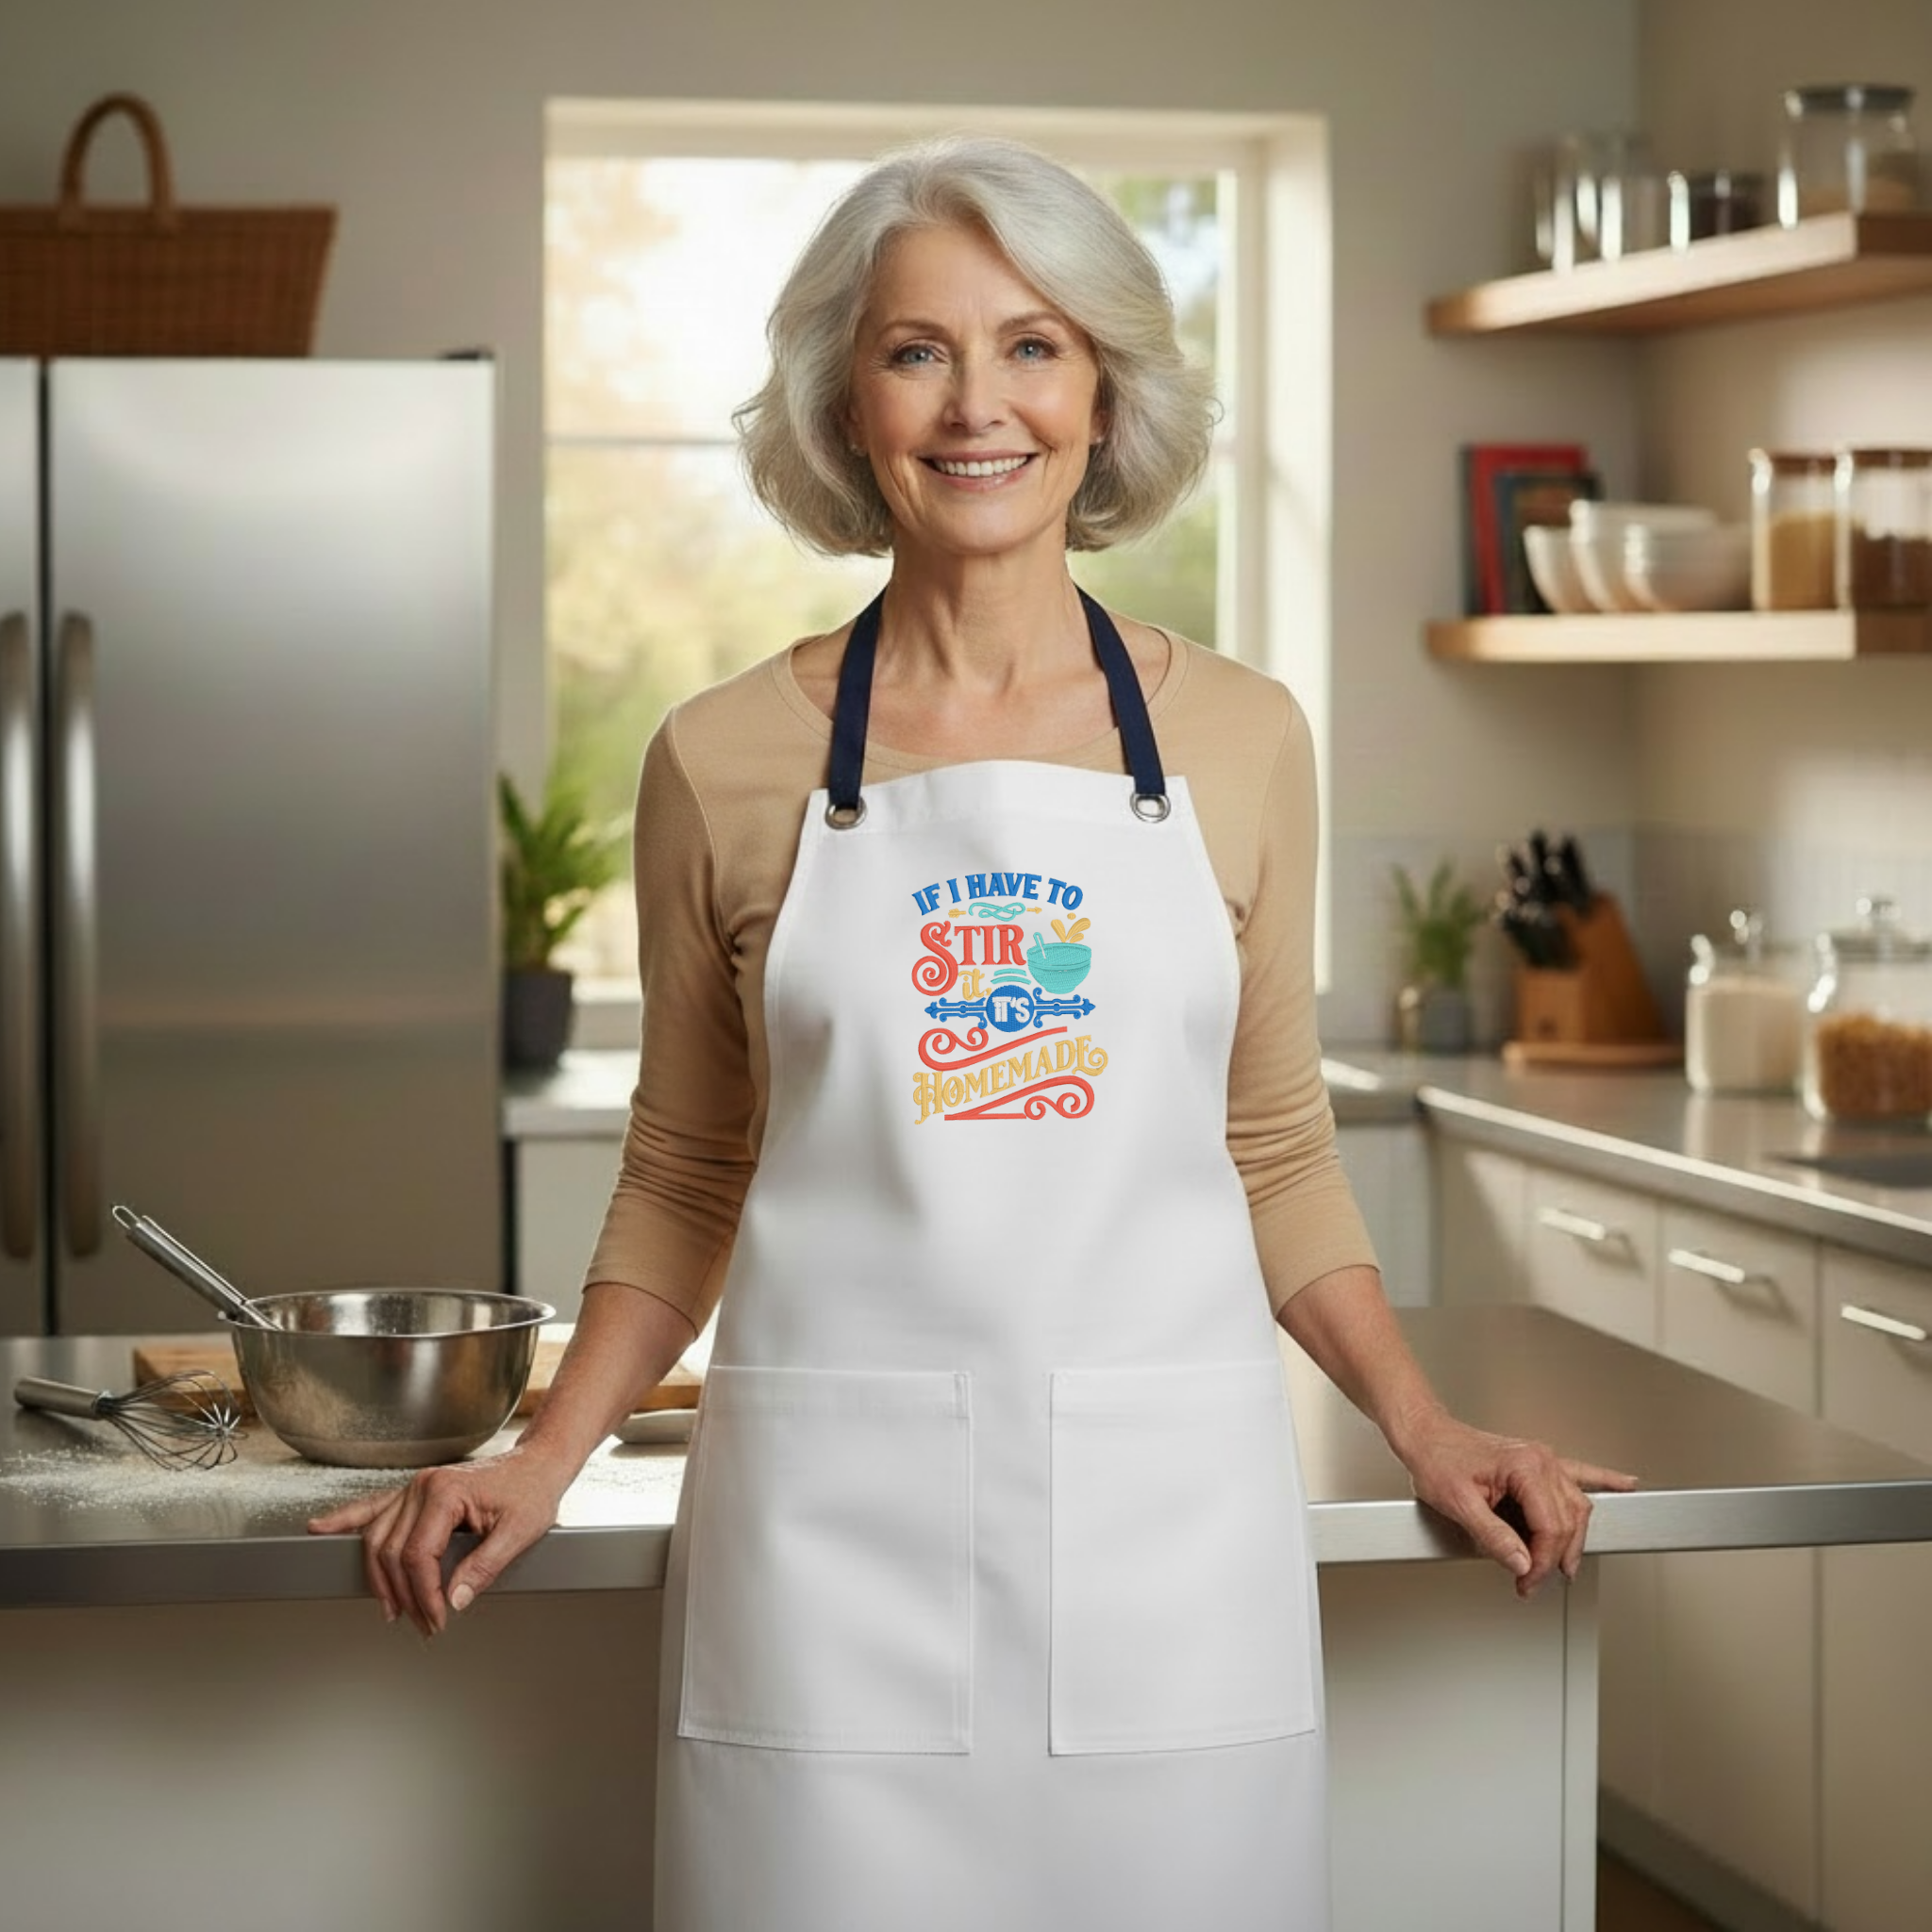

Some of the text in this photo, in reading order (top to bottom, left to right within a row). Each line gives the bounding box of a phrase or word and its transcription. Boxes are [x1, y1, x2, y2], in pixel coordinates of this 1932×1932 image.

[911, 872, 1084, 916] IF I HAVE TO
[911, 920, 1027, 996] STIR
[912, 1034, 1109, 1124] HOMEMADE
